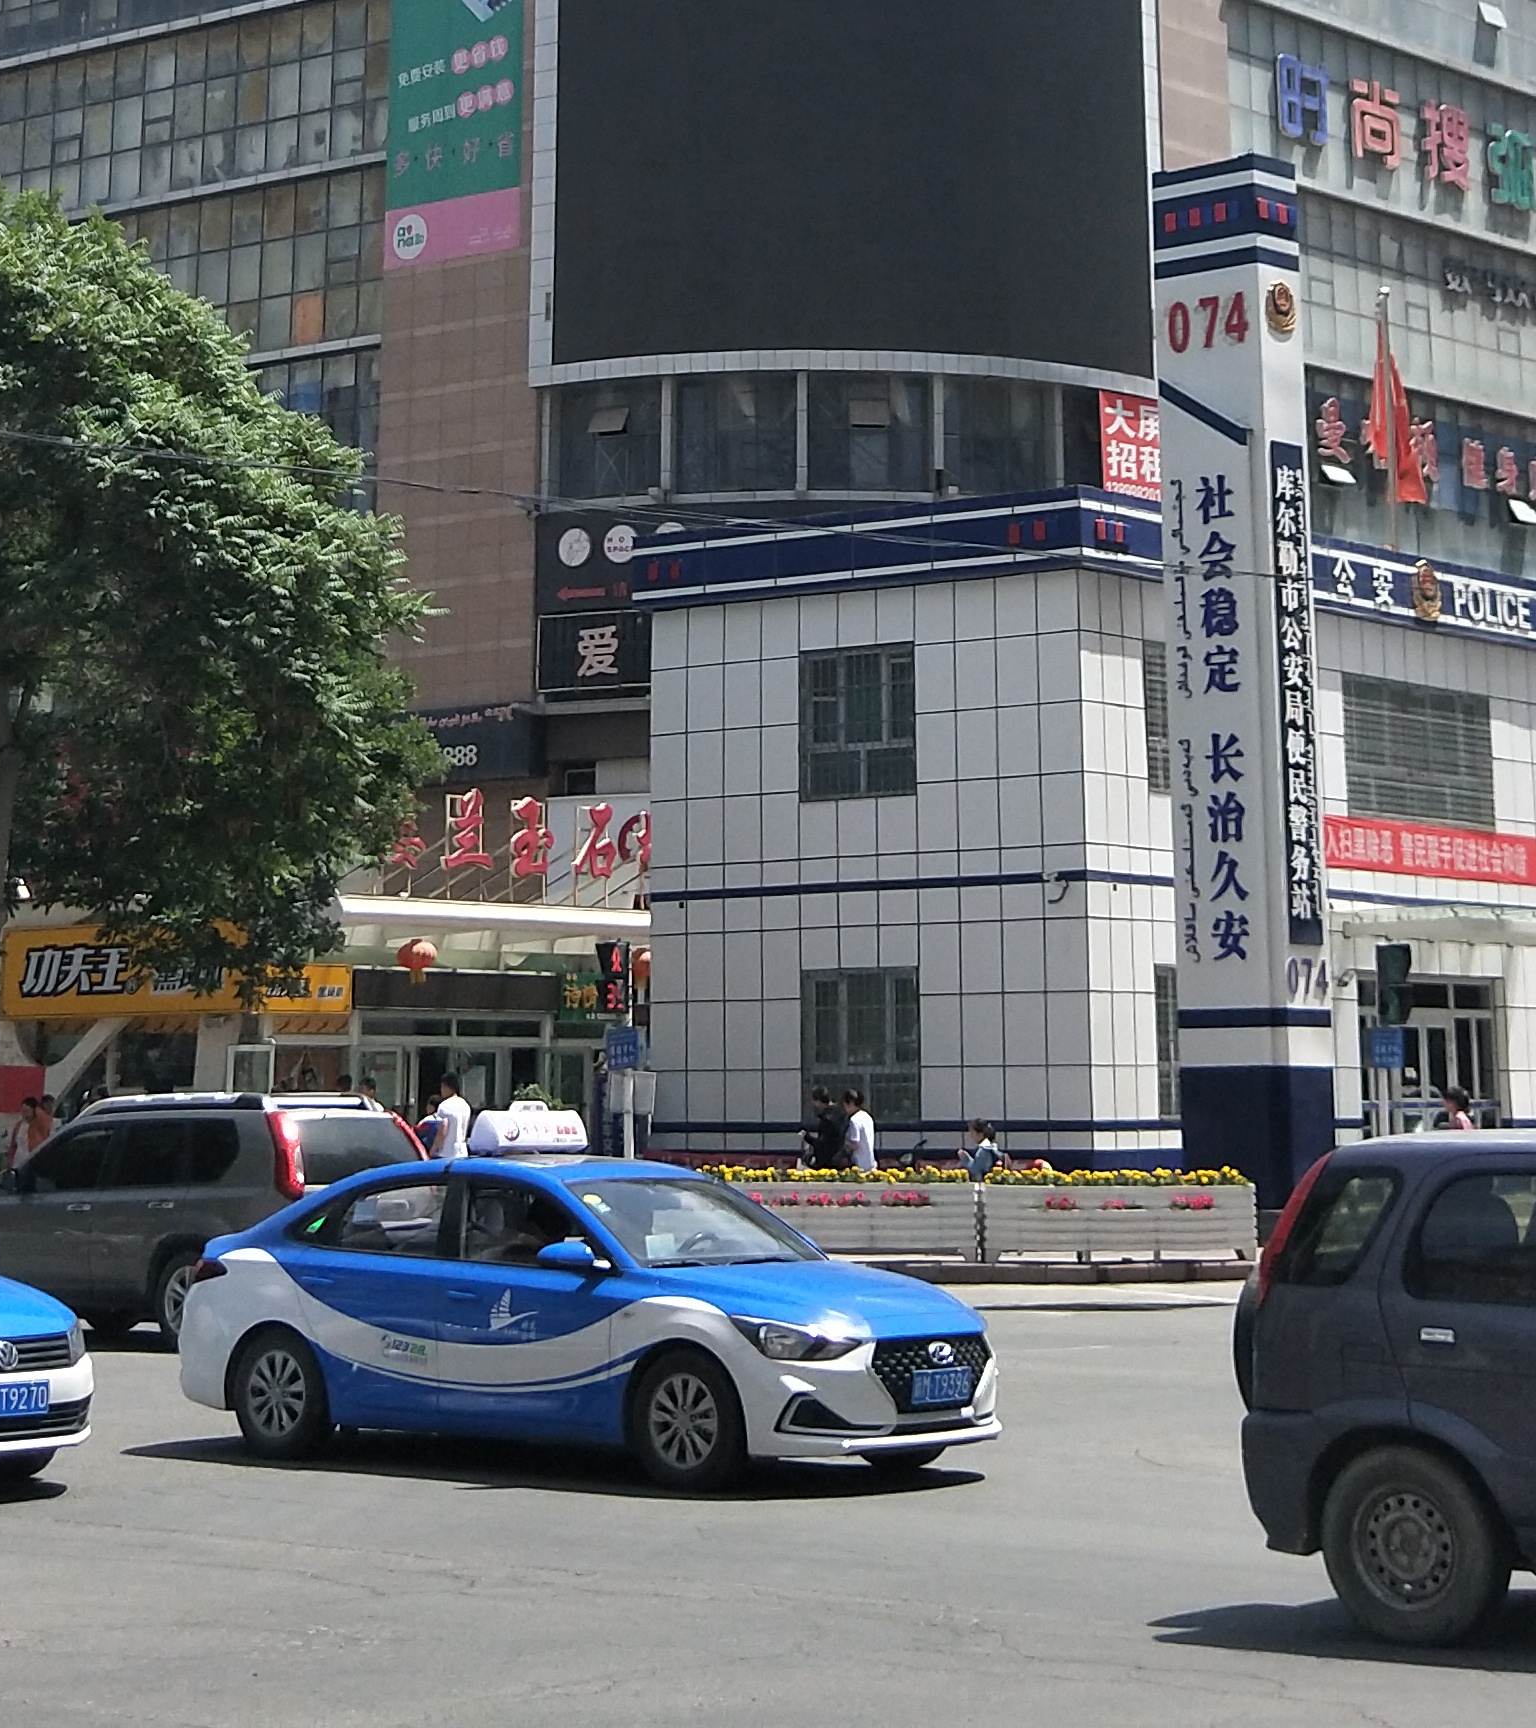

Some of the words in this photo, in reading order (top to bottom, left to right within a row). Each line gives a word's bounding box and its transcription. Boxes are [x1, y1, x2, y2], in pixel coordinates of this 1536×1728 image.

[398, 59, 446, 88] 免费安装
[1168, 292, 1250, 353] 074
[1104, 398, 1161, 442] 大屏
[1105, 439, 1162, 483] 招租
[1195, 474, 1241, 695] 社会稳定
[1333, 557, 1394, 610] 公安
[1452, 579, 1532, 631] POLICE
[577, 625, 619, 677] 爱
[1275, 465, 1313, 920] 库尔勒市公安局便民警务站
[1205, 733, 1250, 961] 长治久安
[22, 945, 129, 997] 功夫王
[1285, 956, 1329, 1001] 074
